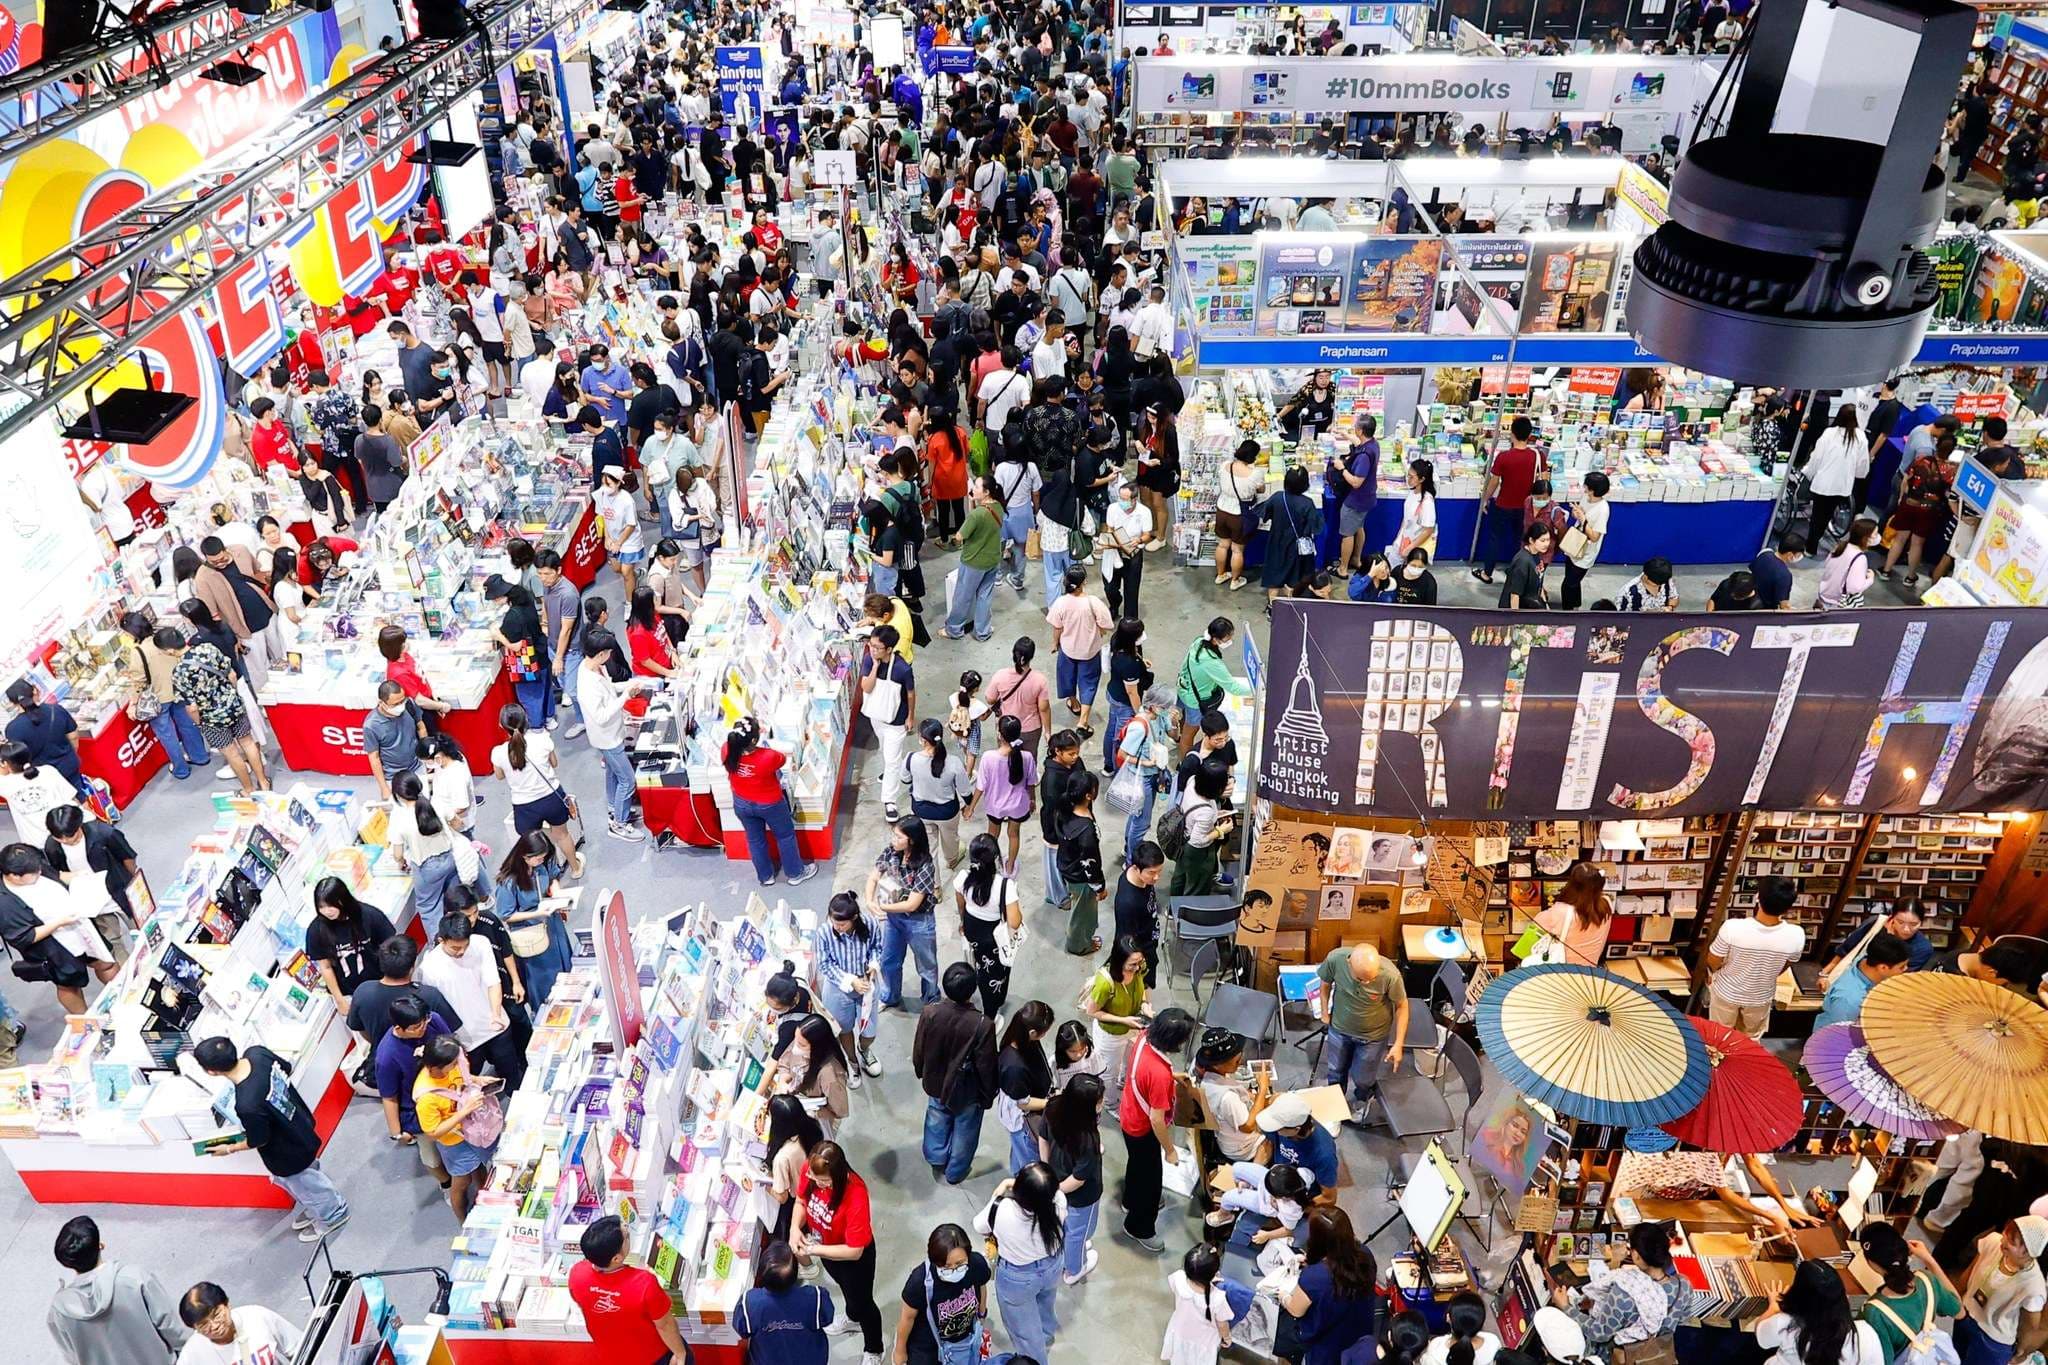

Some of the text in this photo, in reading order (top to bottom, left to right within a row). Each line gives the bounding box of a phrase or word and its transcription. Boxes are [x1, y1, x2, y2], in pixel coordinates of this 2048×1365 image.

[720, 65, 762, 79] นักเขียน
[1325, 78, 1510, 100] #10mmBooks
[1967, 473, 1986, 497] E41
[1273, 734, 1328, 756] Artist
[1277, 747, 1321, 769] House
[1270, 762, 1328, 785] Bangkok
[513, 1225, 540, 1237] TGAT
